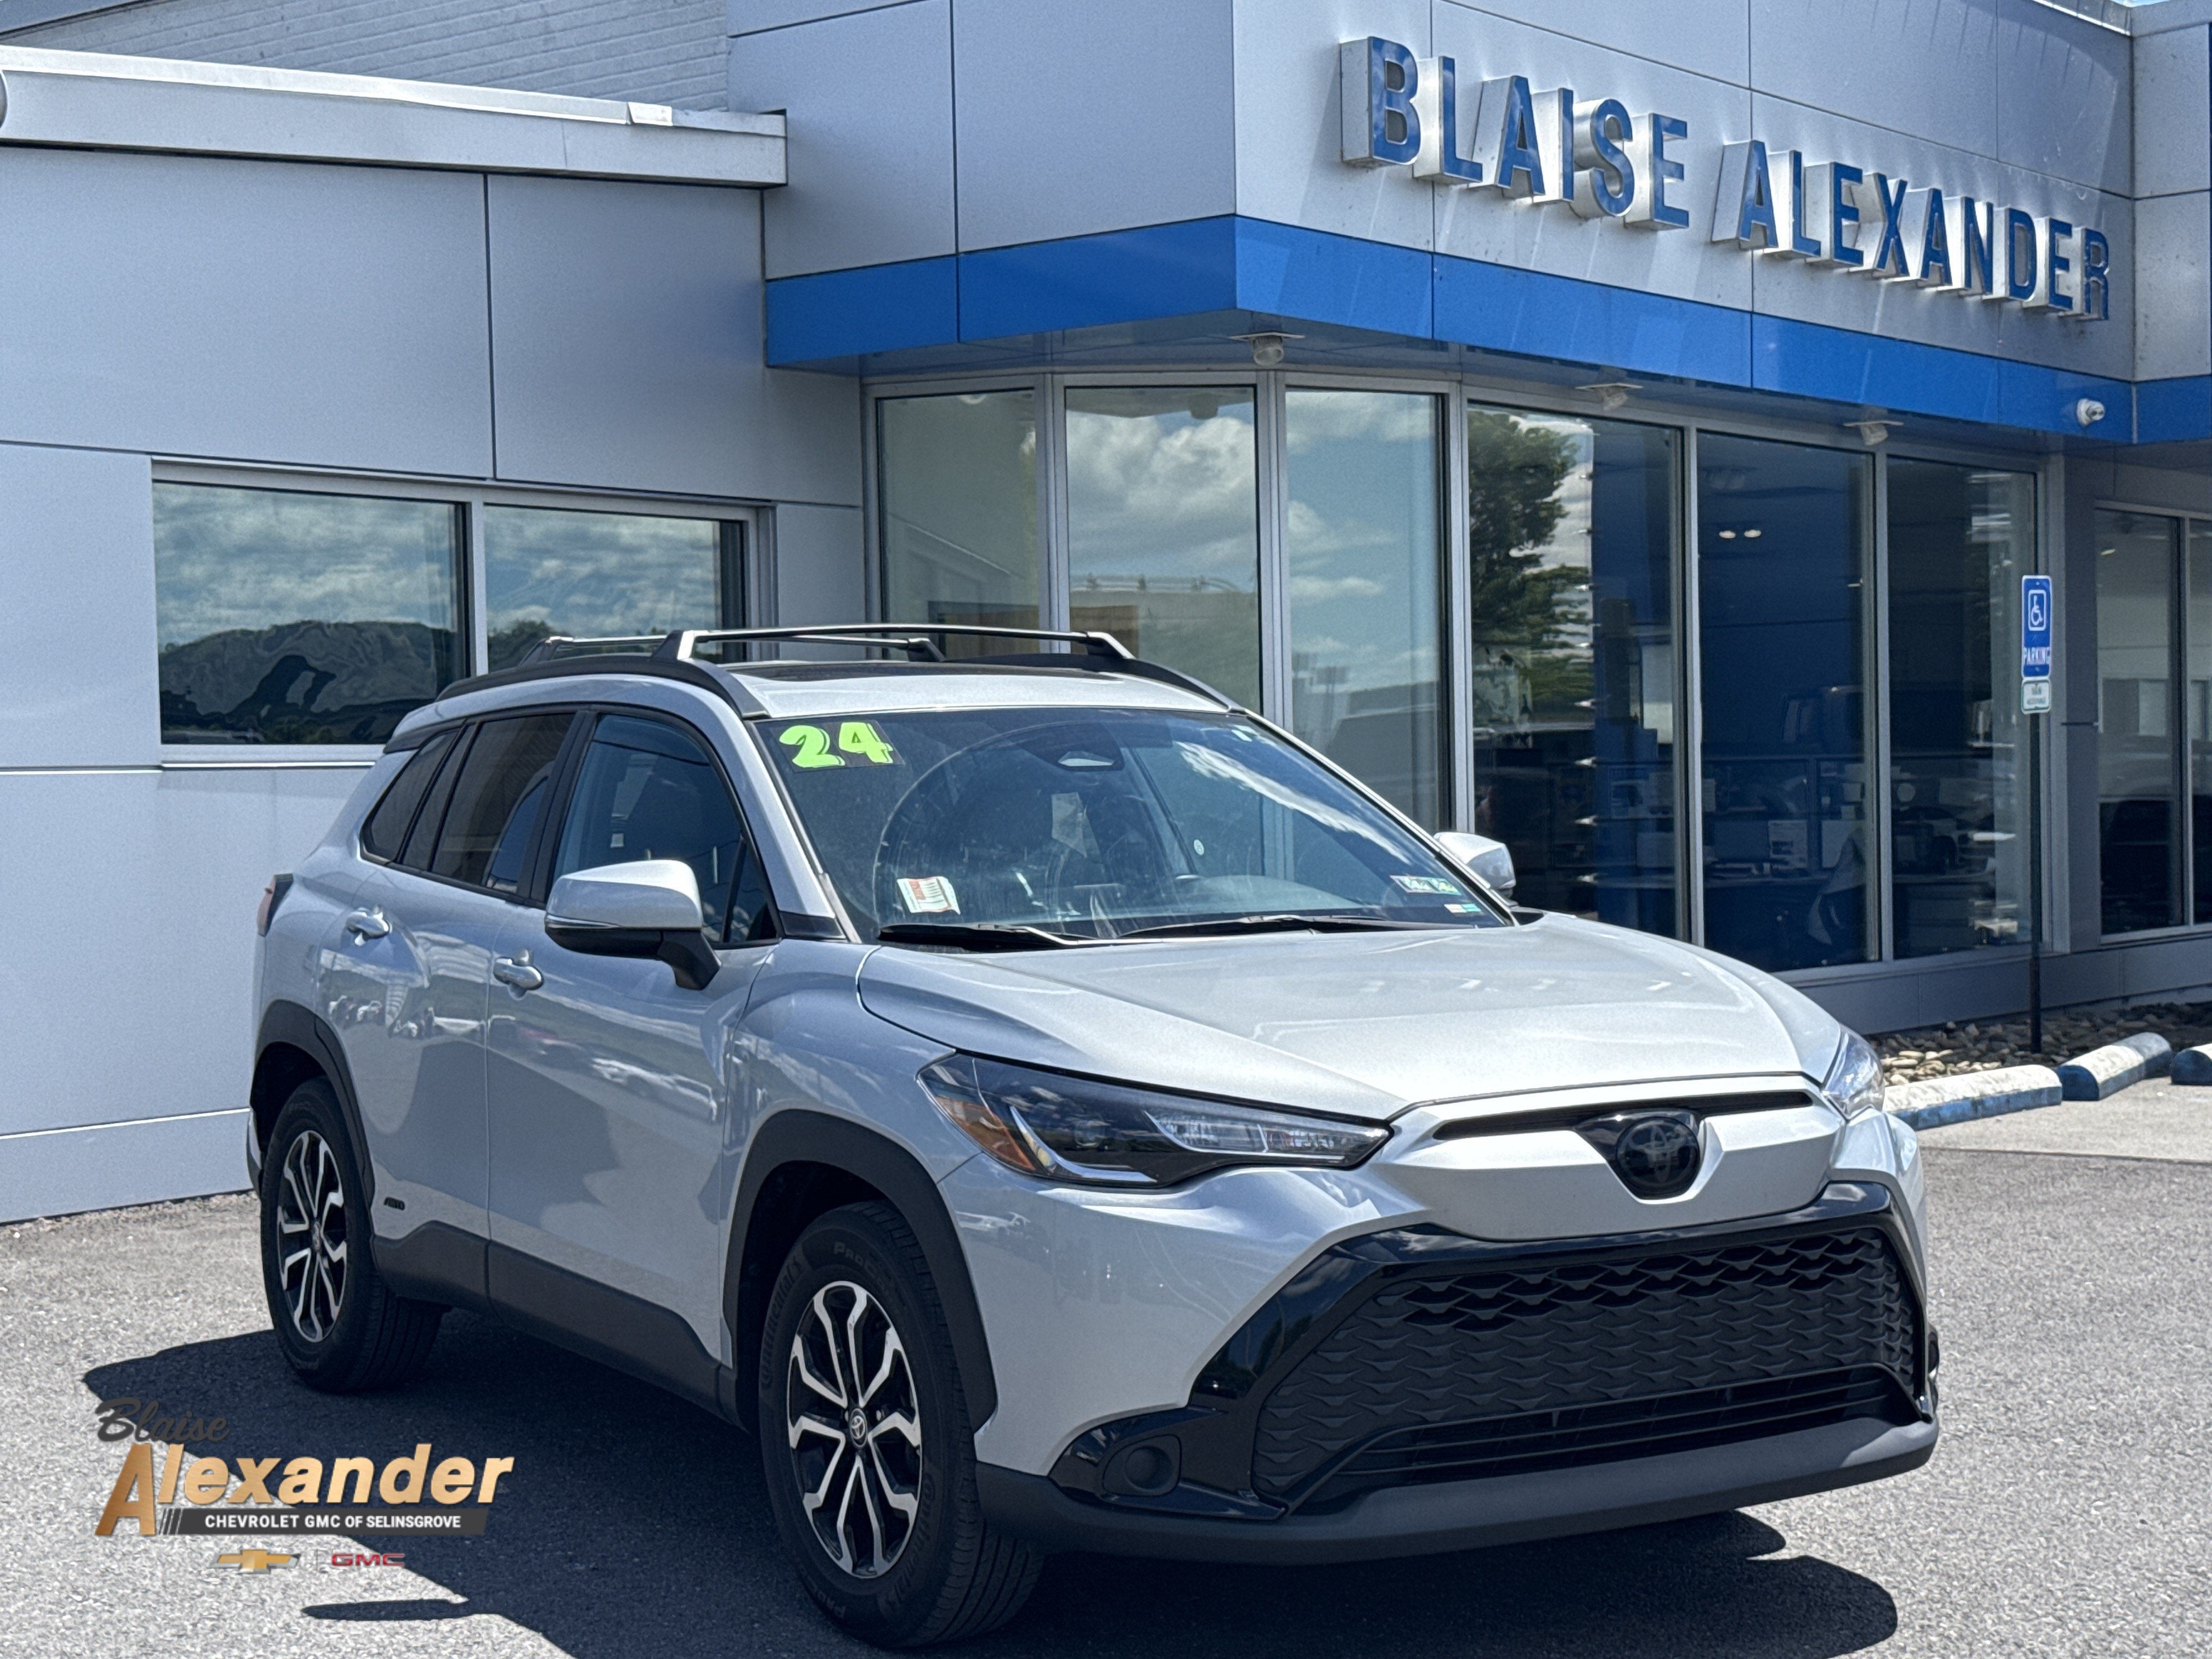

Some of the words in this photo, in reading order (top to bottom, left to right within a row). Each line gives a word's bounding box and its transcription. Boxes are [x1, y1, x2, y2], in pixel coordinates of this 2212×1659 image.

[1367, 36, 1690, 231] BLAISE
[1740, 140, 2109, 321] ALEXANDER
[779, 721, 893, 767] 24
